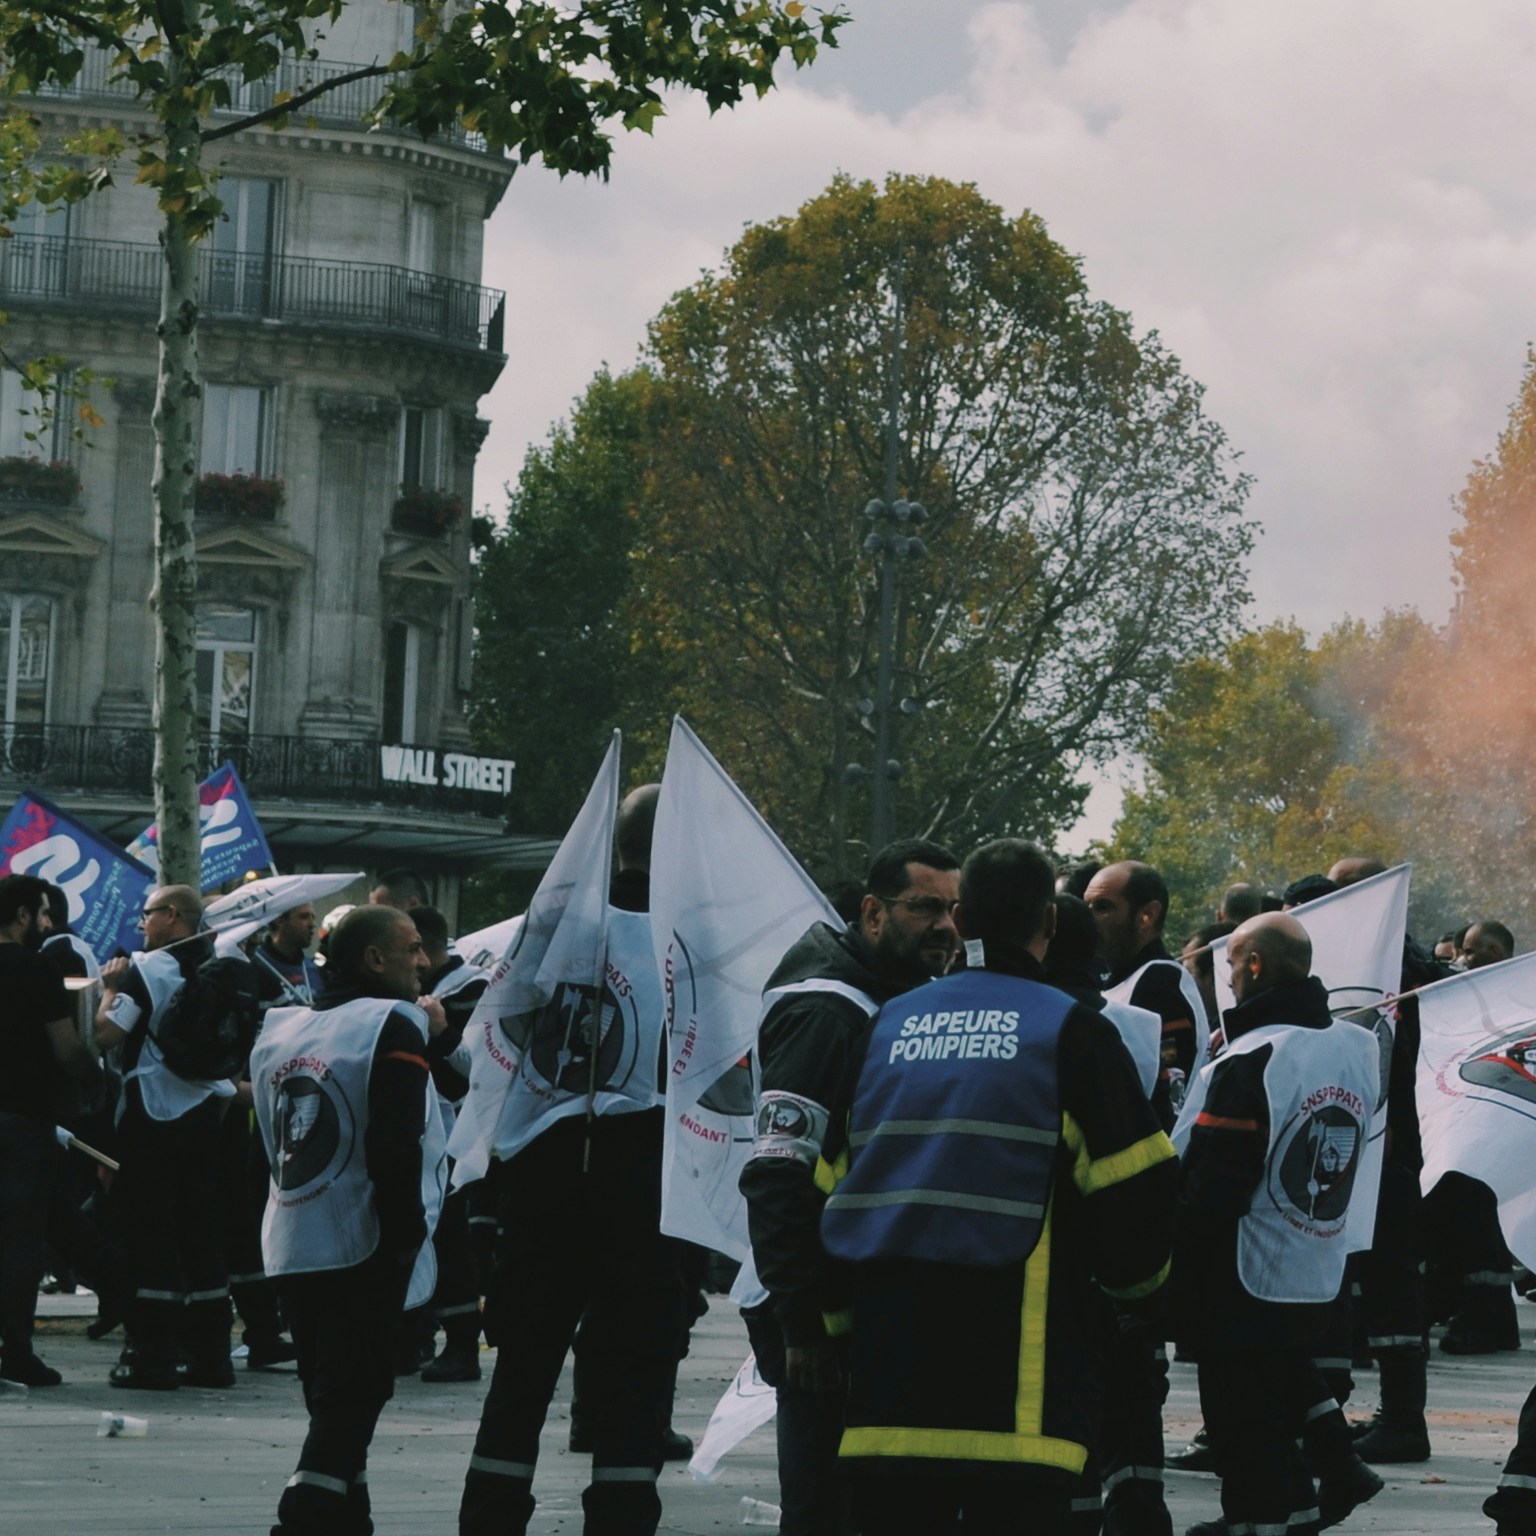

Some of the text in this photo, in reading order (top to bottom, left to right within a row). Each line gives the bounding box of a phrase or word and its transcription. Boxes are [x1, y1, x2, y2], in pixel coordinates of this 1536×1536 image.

[381, 745, 516, 797] WALL STREET
[900, 1010, 1020, 1037] SAPEURS
[889, 1034, 1020, 1064] POMPIERS
[679, 1113, 728, 1144] ENDANT
